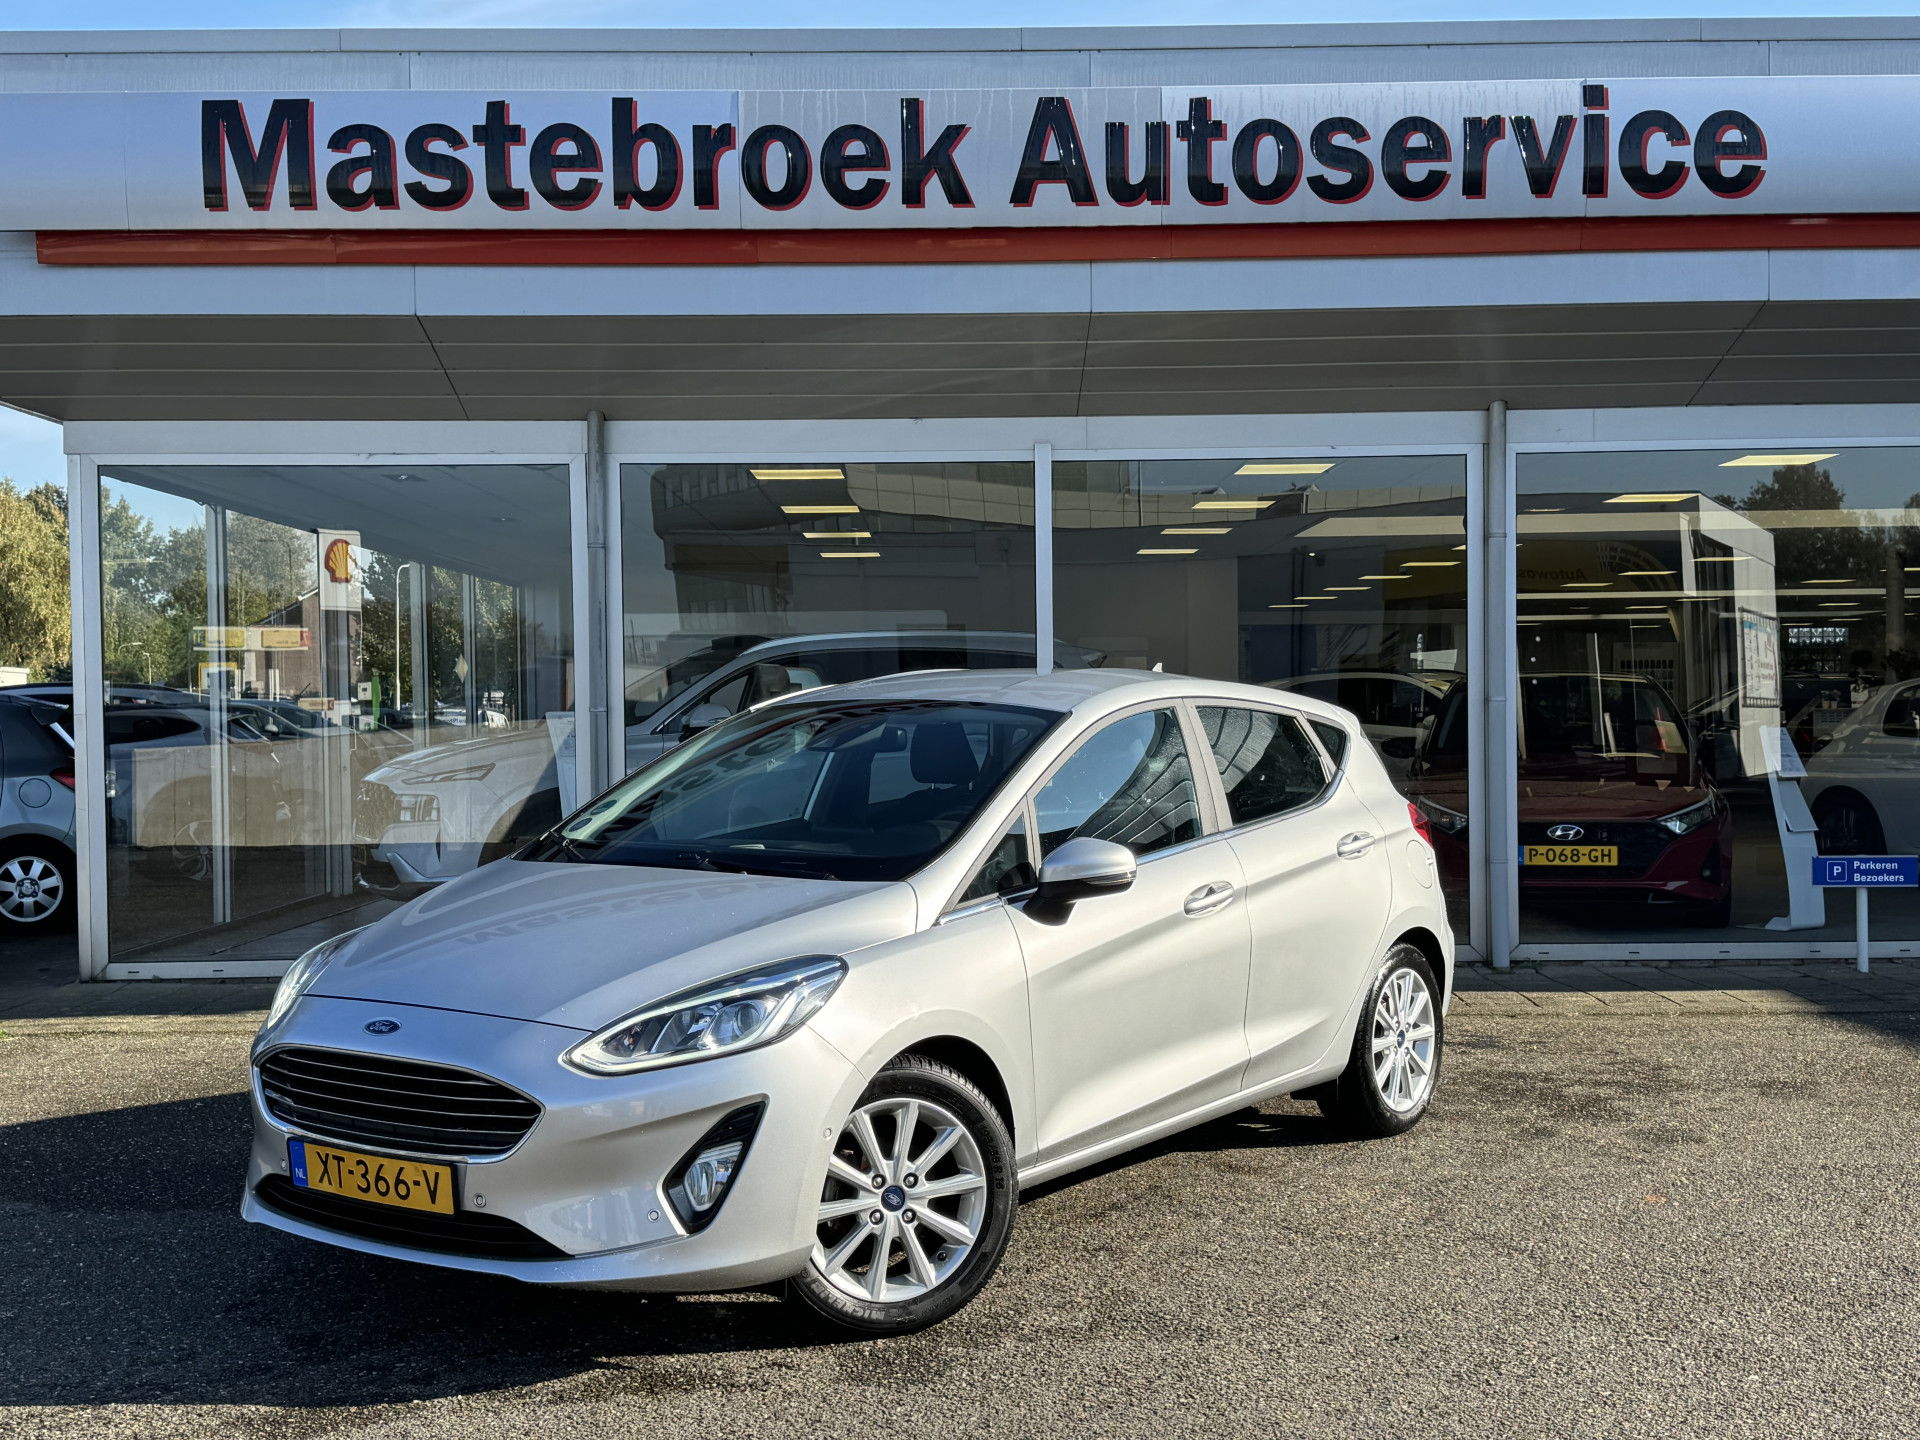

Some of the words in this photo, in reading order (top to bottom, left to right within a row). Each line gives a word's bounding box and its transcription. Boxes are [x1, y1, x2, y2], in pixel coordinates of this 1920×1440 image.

[200, 96, 975, 212] Mastebroek
[1010, 84, 1768, 207] Autoservice
[1528, 848, 1612, 863] P-068-GH
[1853, 861, 1899, 870] Parkeren
[1853, 873, 1905, 883] Bezoekers
[295, 1168, 306, 1179] NL
[316, 1151, 440, 1205] XT-366-V
